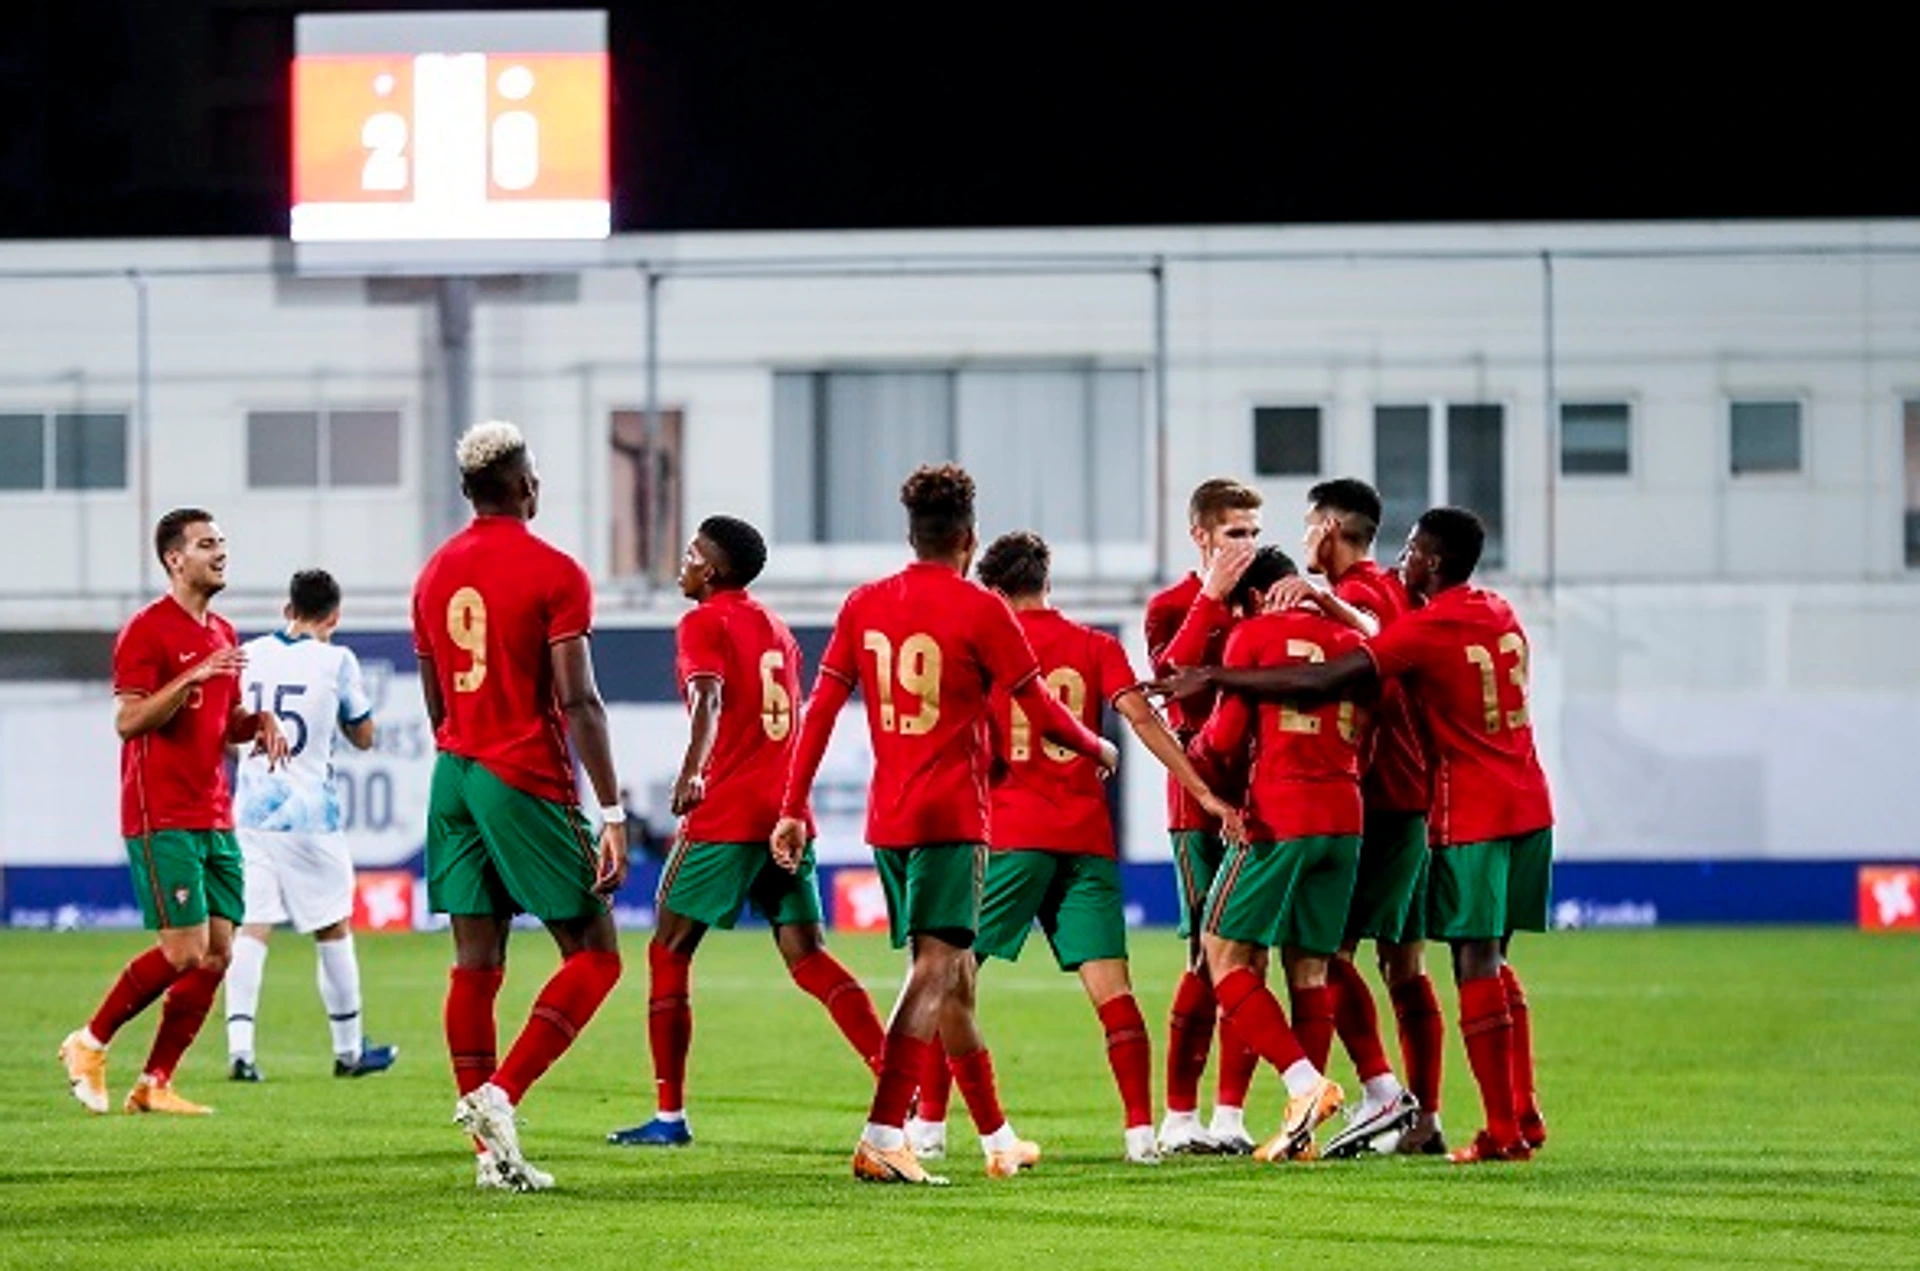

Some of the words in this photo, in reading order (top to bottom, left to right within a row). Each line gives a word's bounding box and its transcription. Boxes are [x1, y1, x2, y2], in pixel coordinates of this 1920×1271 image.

[361, 111, 408, 190] 2
[492, 110, 538, 190] 0
[446, 586, 487, 692] 9
[863, 630, 943, 735] 19
[1465, 633, 1530, 734] 13
[248, 681, 308, 758] 15
[759, 650, 791, 741] 6
